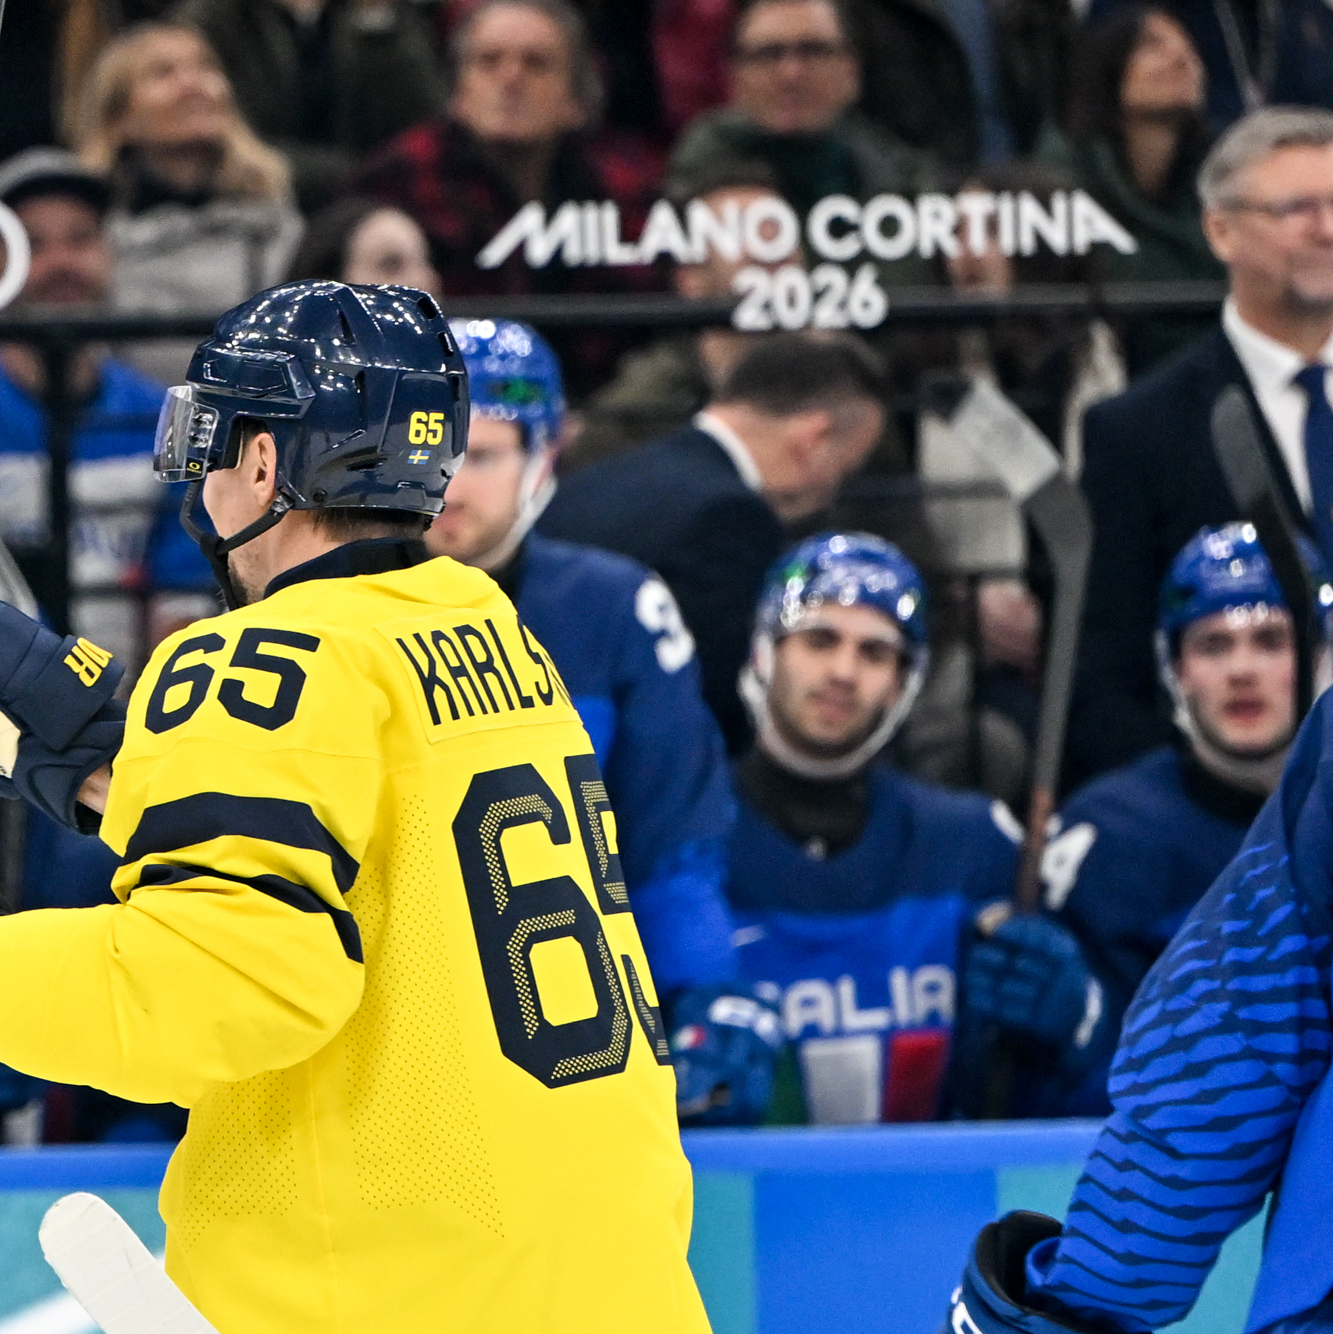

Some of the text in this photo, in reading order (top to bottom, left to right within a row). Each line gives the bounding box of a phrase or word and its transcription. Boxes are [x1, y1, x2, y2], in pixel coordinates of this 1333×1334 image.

[475, 189, 1139, 269] MILANO CORTINA
[730, 262, 889, 331] 2026
[408, 410, 445, 446] 65
[143, 626, 321, 735] 65
[395, 613, 571, 727] KARLS
[754, 962, 957, 1039] ALIA
